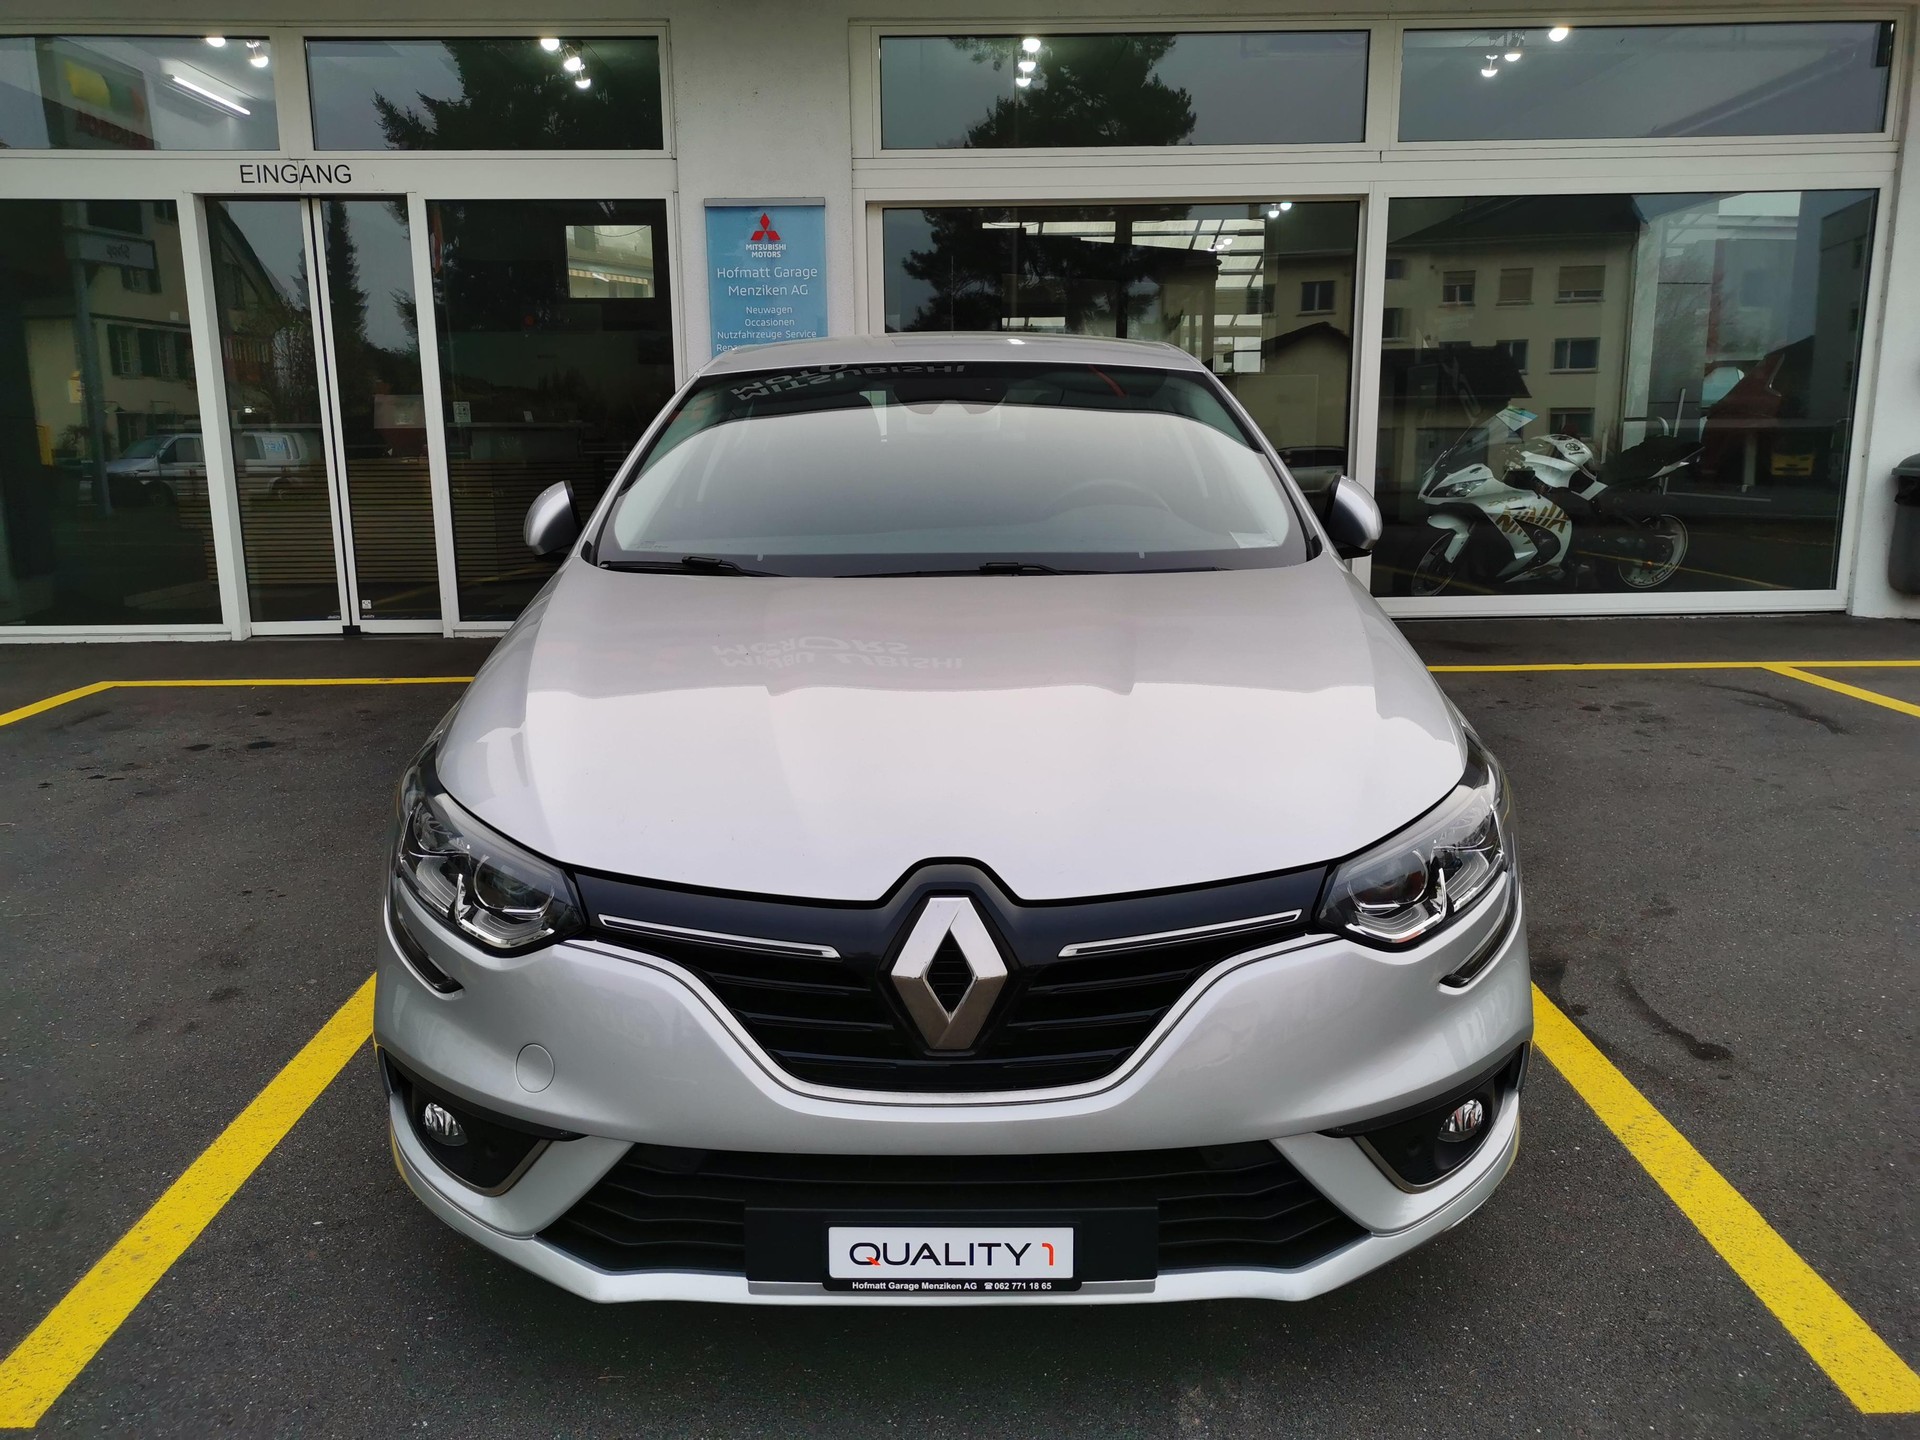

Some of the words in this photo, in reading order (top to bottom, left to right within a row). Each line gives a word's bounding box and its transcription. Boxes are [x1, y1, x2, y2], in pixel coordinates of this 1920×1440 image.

[240, 164, 352, 184] EINGANG
[717, 267, 770, 279] Hofmatt
[774, 266, 818, 280] Garage
[728, 285, 788, 296] Menziken
[791, 284, 808, 296] AG
[746, 306, 793, 315] Neuwagen
[744, 318, 795, 327] Occasionen
[717, 331, 782, 339] Nutzfahrzeuge
[785, 330, 817, 338] Service
[849, 1242, 1032, 1266] QUALITY
[1042, 1242, 1055, 1266] 1
[852, 1281, 887, 1290] Hofmatt
[888, 1281, 920, 1292] Garage
[921, 1281, 963, 1290] Menziken
[964, 1281, 978, 1290] AG
[994, 1281, 1010, 1290] 062
[1012, 1281, 1027, 1290] 771
[1030, 1281, 1040, 1290] 18
[1041, 1281, 1052, 1290] 65
